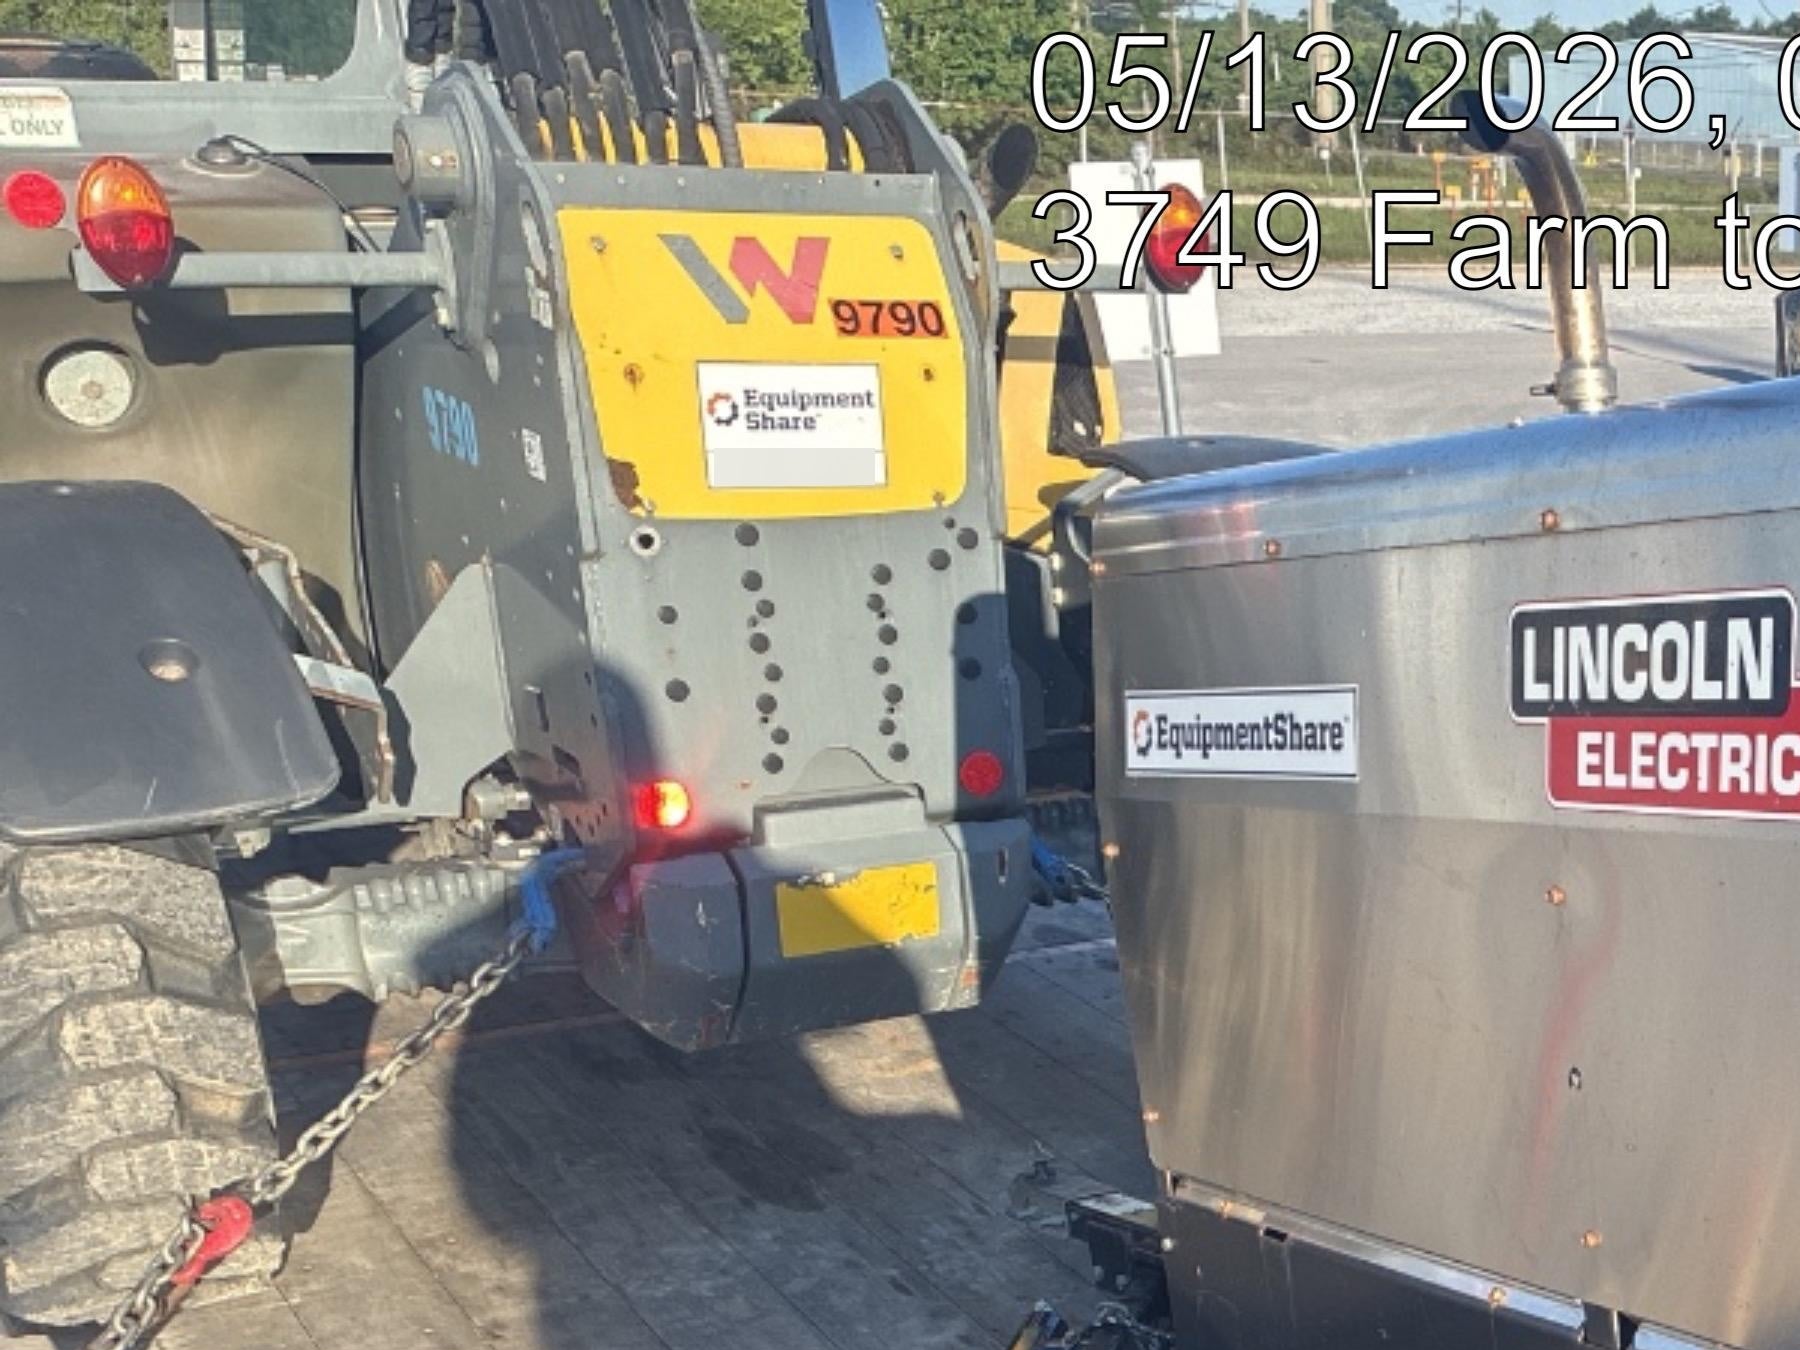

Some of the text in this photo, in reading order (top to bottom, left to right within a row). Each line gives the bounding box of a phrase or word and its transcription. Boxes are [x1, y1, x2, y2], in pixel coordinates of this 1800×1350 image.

[11, 119, 64, 136] ONLY
[831, 299, 946, 336] 9790
[743, 388, 875, 411] Equipment
[744, 411, 817, 431] Share
[1522, 616, 1775, 703] LINCOLN
[1155, 711, 1345, 760] EquipmentShare
